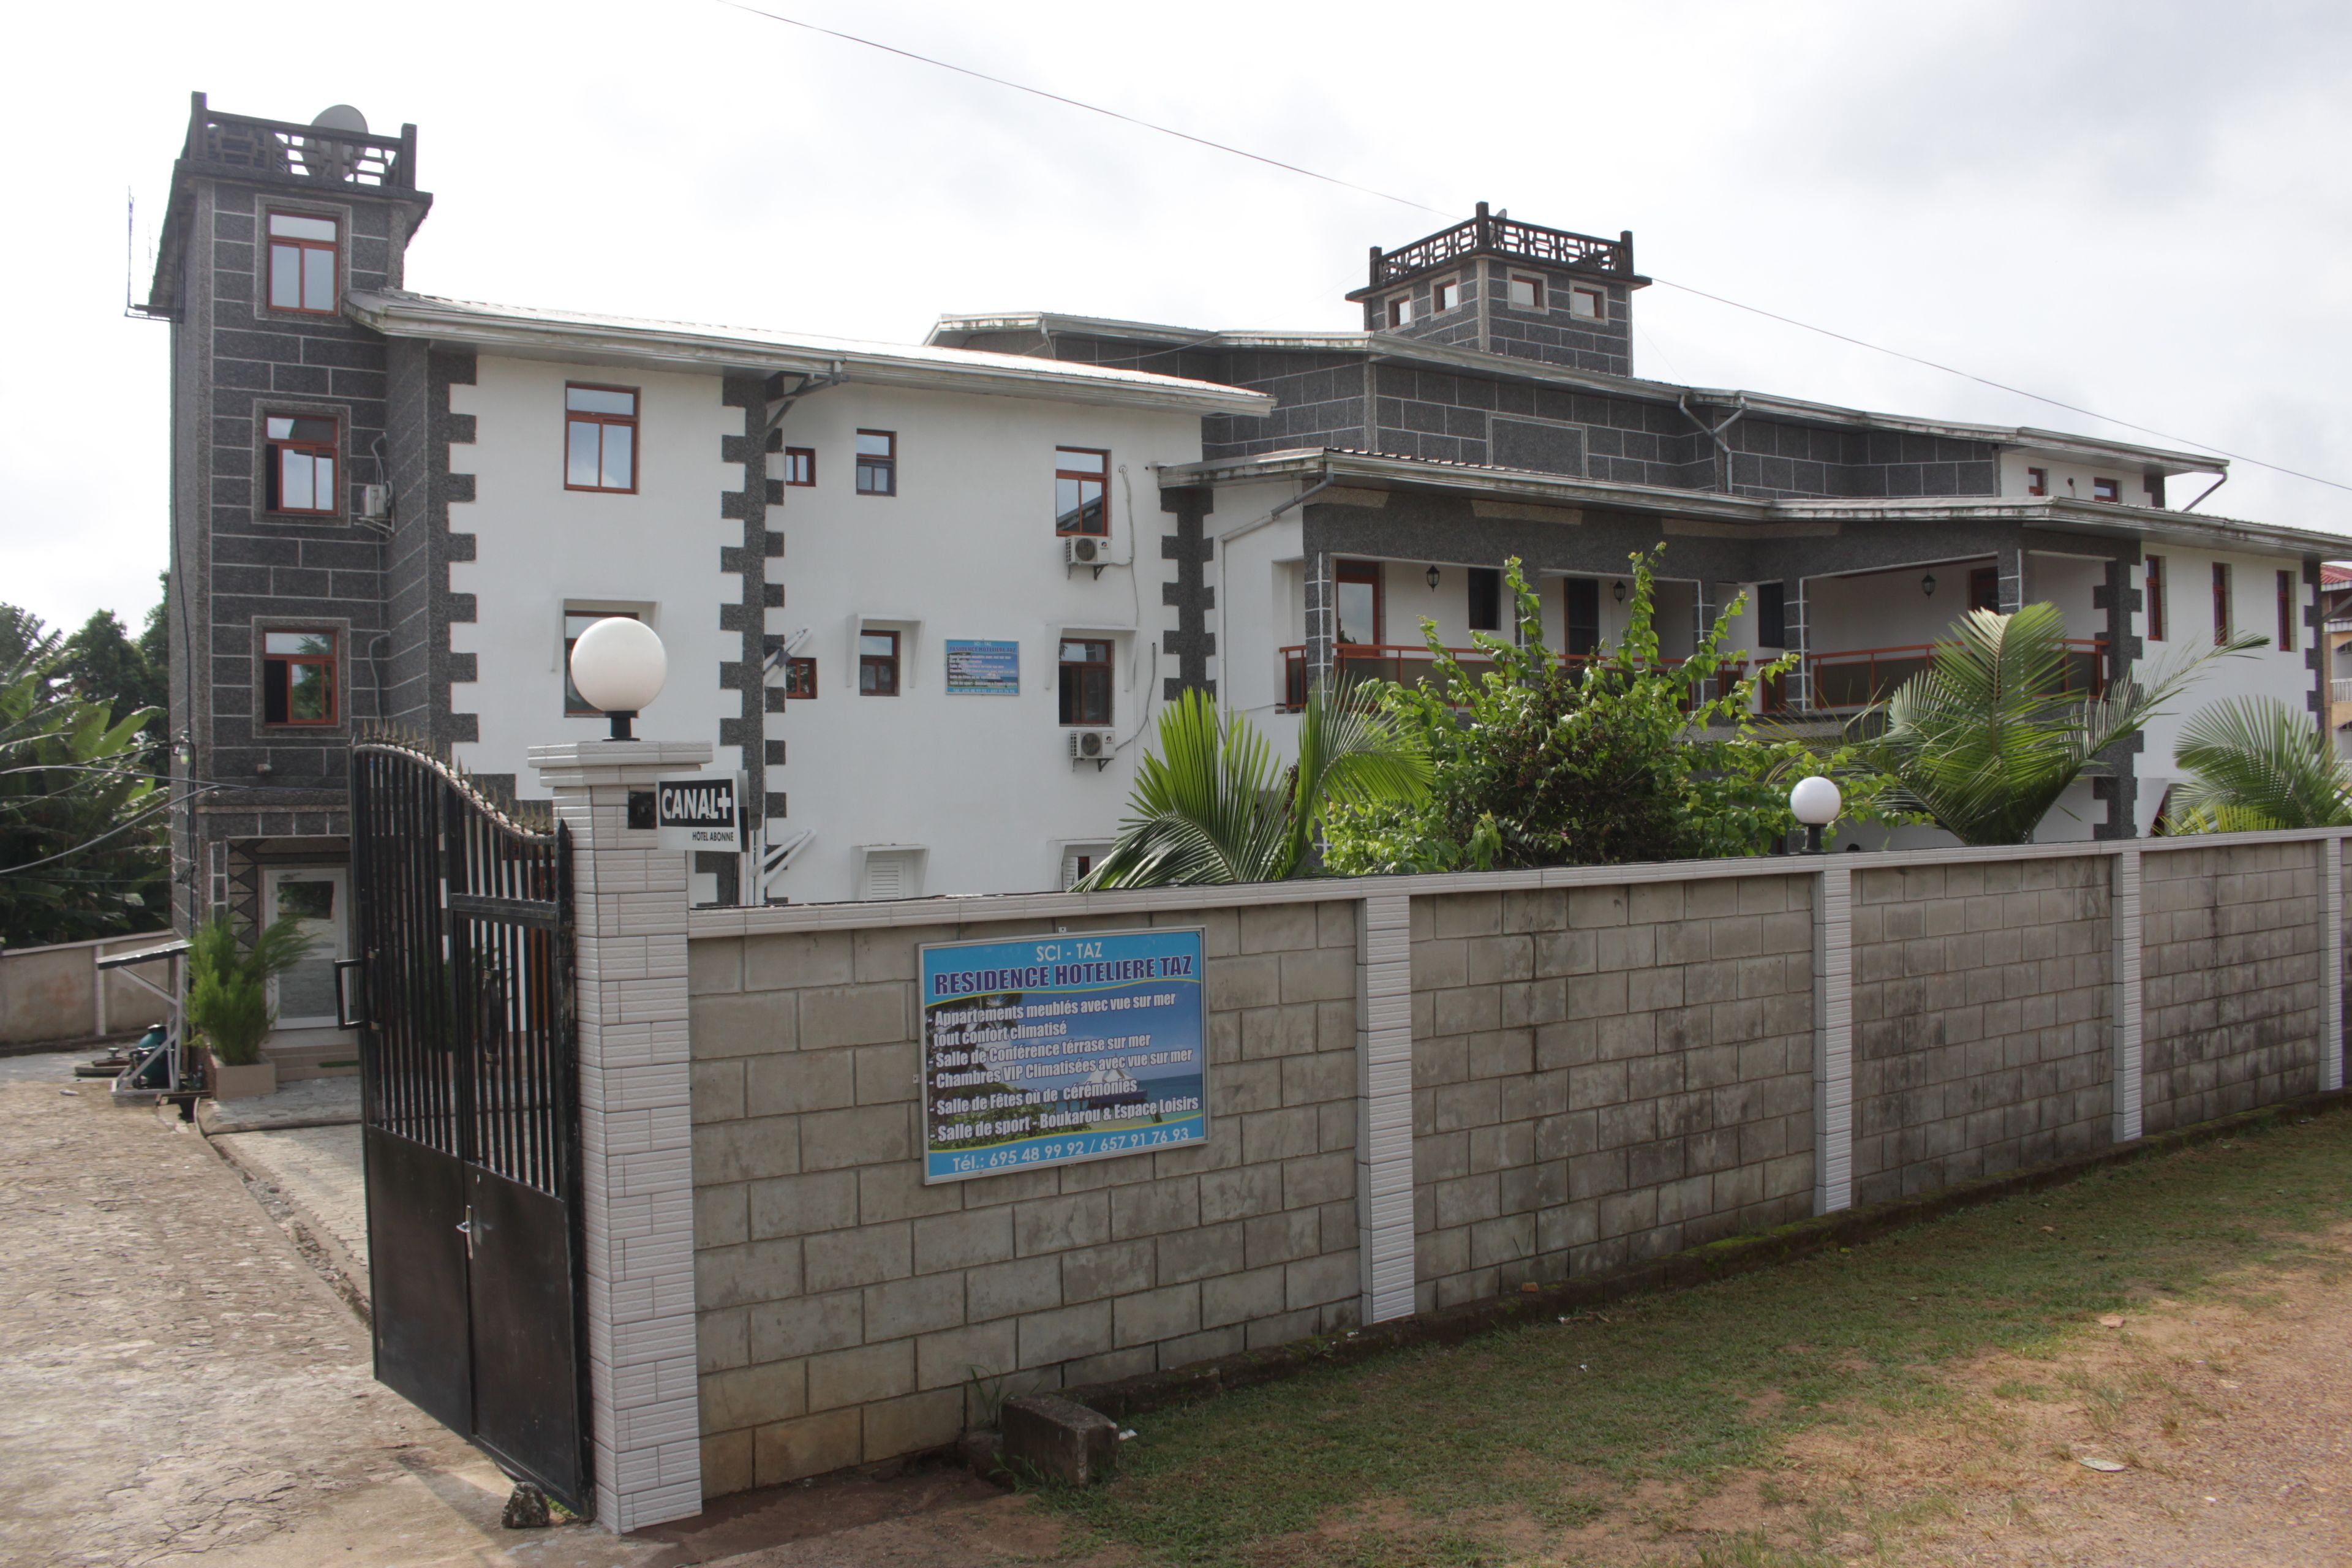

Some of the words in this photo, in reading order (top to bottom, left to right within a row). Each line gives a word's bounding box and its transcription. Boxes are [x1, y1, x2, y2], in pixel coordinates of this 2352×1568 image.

[662, 787, 731, 820] CANAL+
[710, 831, 734, 842] ABONNE
[1036, 944, 1061, 962] SCI
[1076, 942, 1102, 959] TAZ
[934, 966, 1049, 995] RESIDENCE
[1055, 957, 1155, 986] HOTELIERE
[1159, 955, 1193, 977] TAZ
[935, 1006, 1023, 1028] Appartements
[1026, 999, 1078, 1018] meublés
[1080, 999, 1108, 1013] avec
[1110, 997, 1131, 1011] vue
[1133, 995, 1152, 1008] sur
[1154, 993, 1176, 1006] mer
[933, 1033, 960, 1047] tout
[962, 1027, 1008, 1045] confort
[1011, 1020, 1067, 1039] climatisé
[936, 1050, 968, 1068] Salle
[971, 1049, 987, 1065] de
[989, 1042, 1059, 1063] Conférence
[1062, 1038, 1105, 1055] térrase
[1107, 1036, 1126, 1050] sur
[1128, 1034, 1151, 1048] mer
[937, 1069, 1001, 1088] Chambres
[1002, 1065, 1023, 1082] VIP
[1025, 1058, 1096, 1079] Climatisées
[1098, 1057, 1126, 1071] avec
[1128, 1054, 1148, 1068] vue
[1150, 1053, 1168, 1065] sur
[1170, 1049, 1193, 1063] mer
[937, 1098, 969, 1115] Salle
[972, 1096, 987, 1111] de
[990, 1093, 1023, 1109] Fêtes
[1025, 1088, 1041, 1105] où
[1043, 1087, 1058, 1102] de
[1063, 1077, 1137, 1100] cérémonies
[938, 1123, 973, 1142] Salle
[975, 1120, 992, 1137] de
[995, 1116, 1030, 1135] sport
[1039, 1109, 1101, 1129] Boukarou
[1103, 1107, 1112, 1120] &
[1114, 1104, 1157, 1120] Espace
[1159, 1096, 1199, 1114] Loisirs
[989, 1150, 1017, 1167] 695
[1022, 1147, 1039, 1161] 48
[1044, 1144, 1061, 1159] 99
[1067, 1141, 1084, 1155] 92
[1088, 1139, 1095, 1153] /
[1100, 1136, 1126, 1151] 657
[1131, 1133, 1145, 1147] 91
[1152, 1131, 1167, 1144] 76
[1172, 1127, 1189, 1140] 93
